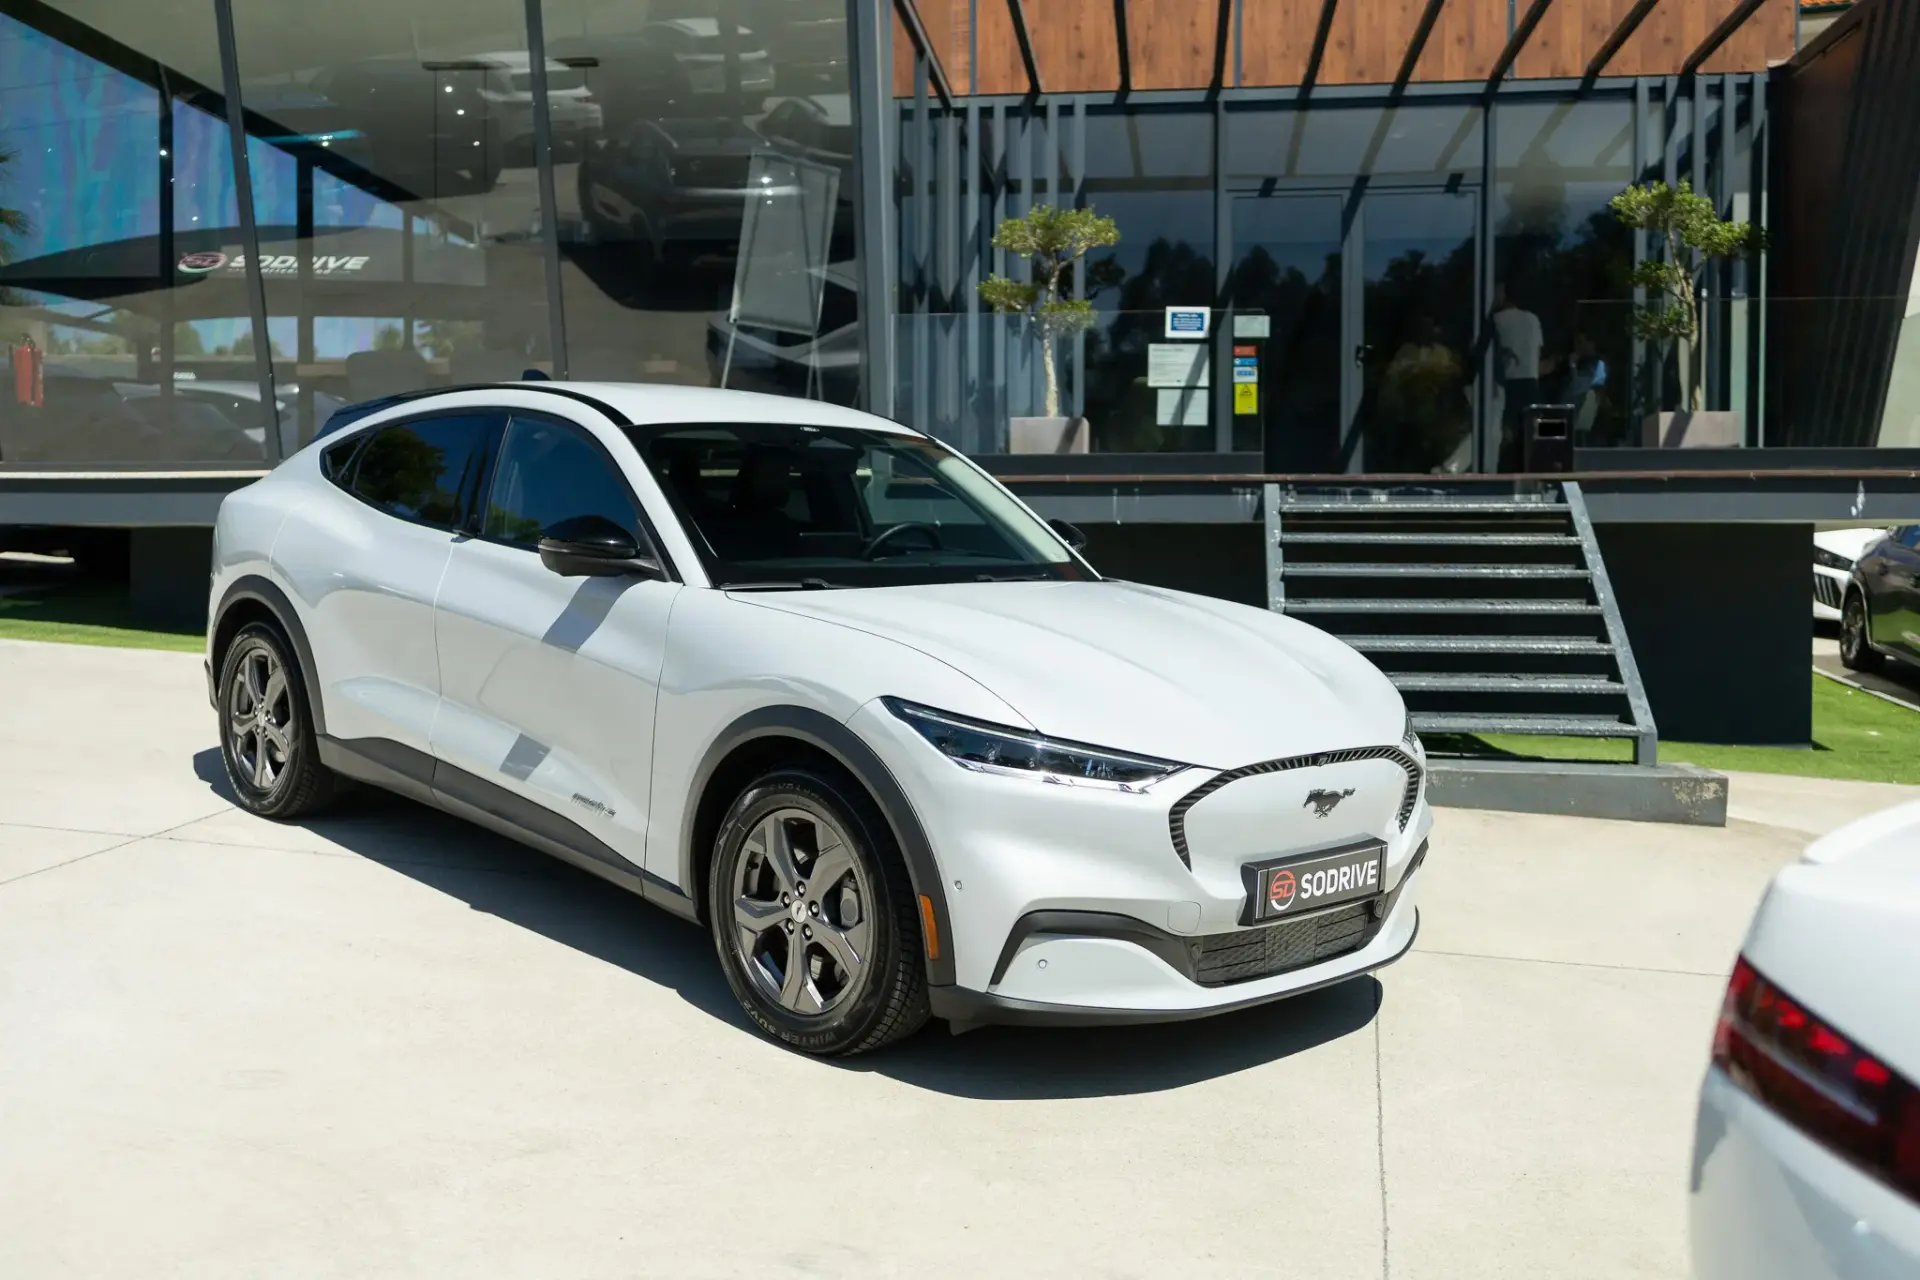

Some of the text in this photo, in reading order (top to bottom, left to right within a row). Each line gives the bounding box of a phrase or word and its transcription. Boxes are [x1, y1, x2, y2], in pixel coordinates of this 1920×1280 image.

[229, 255, 370, 269] SODIVE
[1270, 859, 1378, 900] SD SODRIVE
[781, 1031, 836, 1045] WINTER
